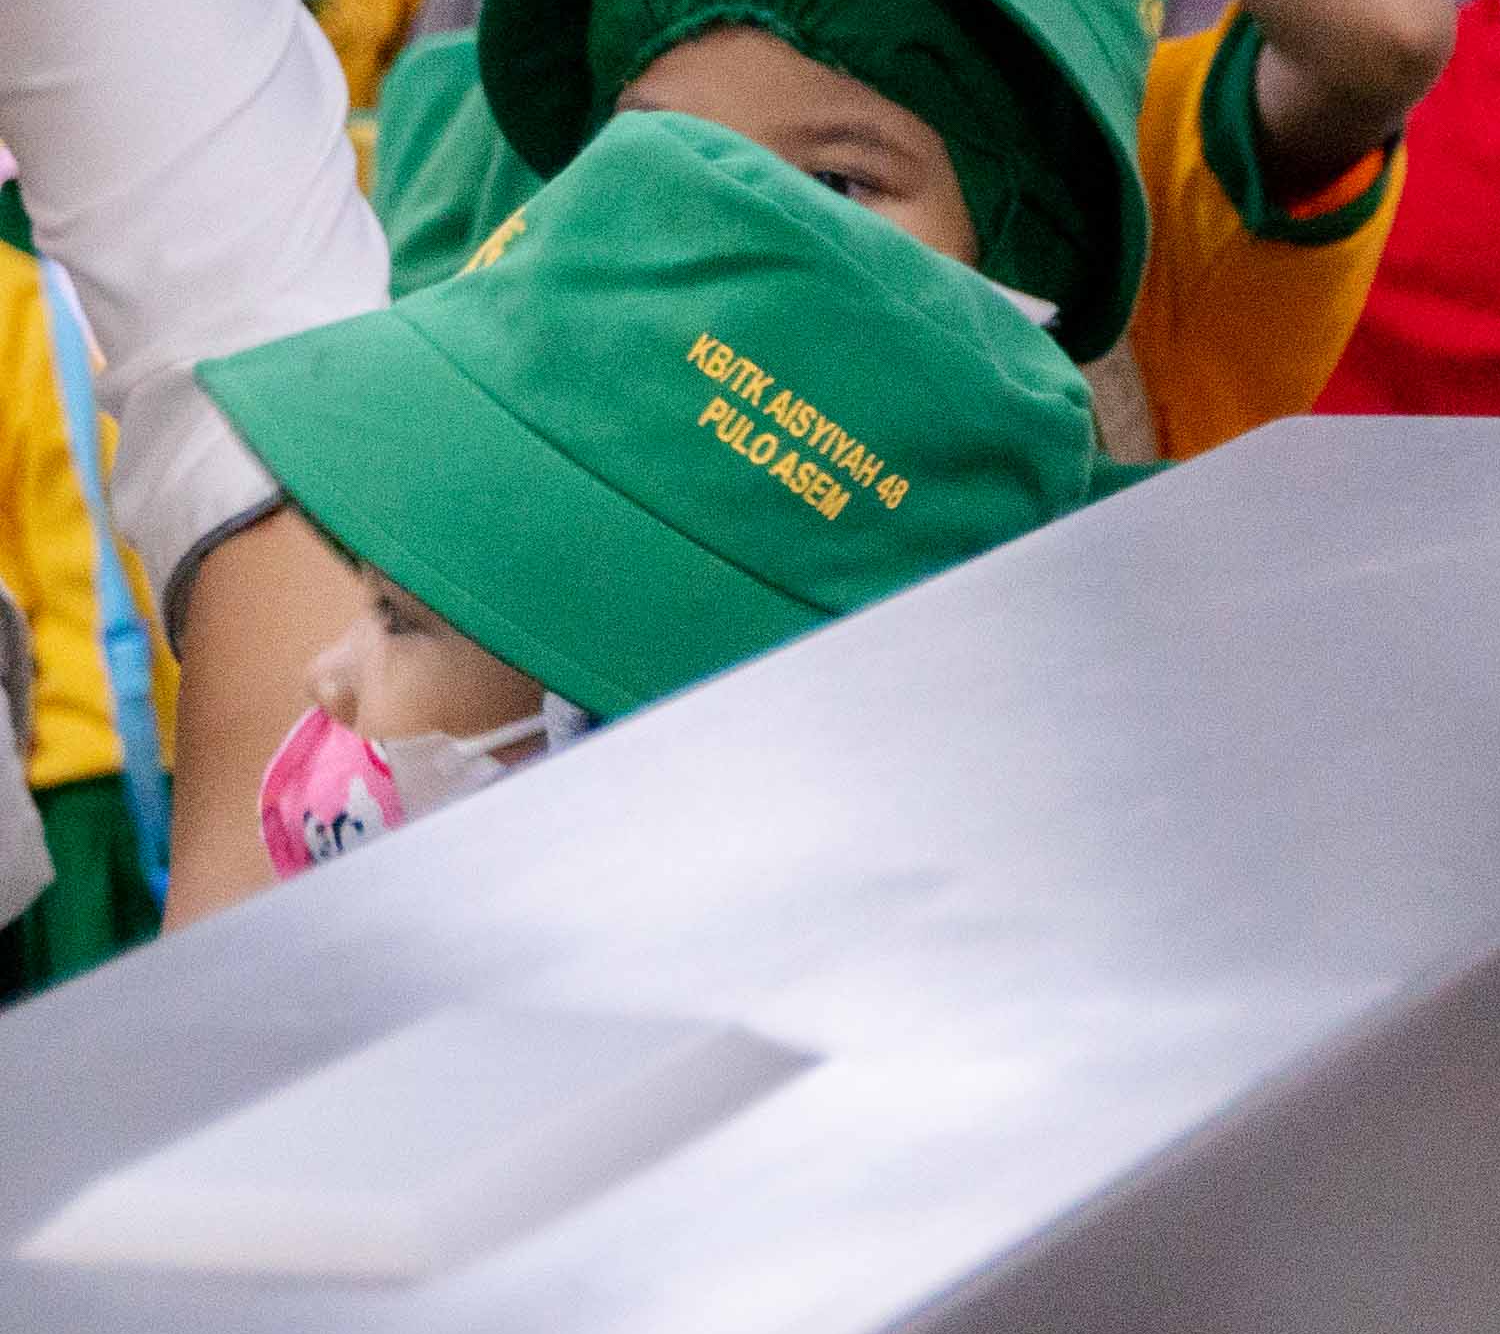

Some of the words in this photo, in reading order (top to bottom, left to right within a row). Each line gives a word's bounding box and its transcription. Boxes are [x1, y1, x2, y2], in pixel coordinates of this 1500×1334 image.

[687, 332, 775, 407] KB/TK
[764, 389, 885, 488] AISYIYAH
[875, 473, 911, 511] 48
[697, 396, 779, 466] PULO
[768, 451, 852, 522] ASEM
